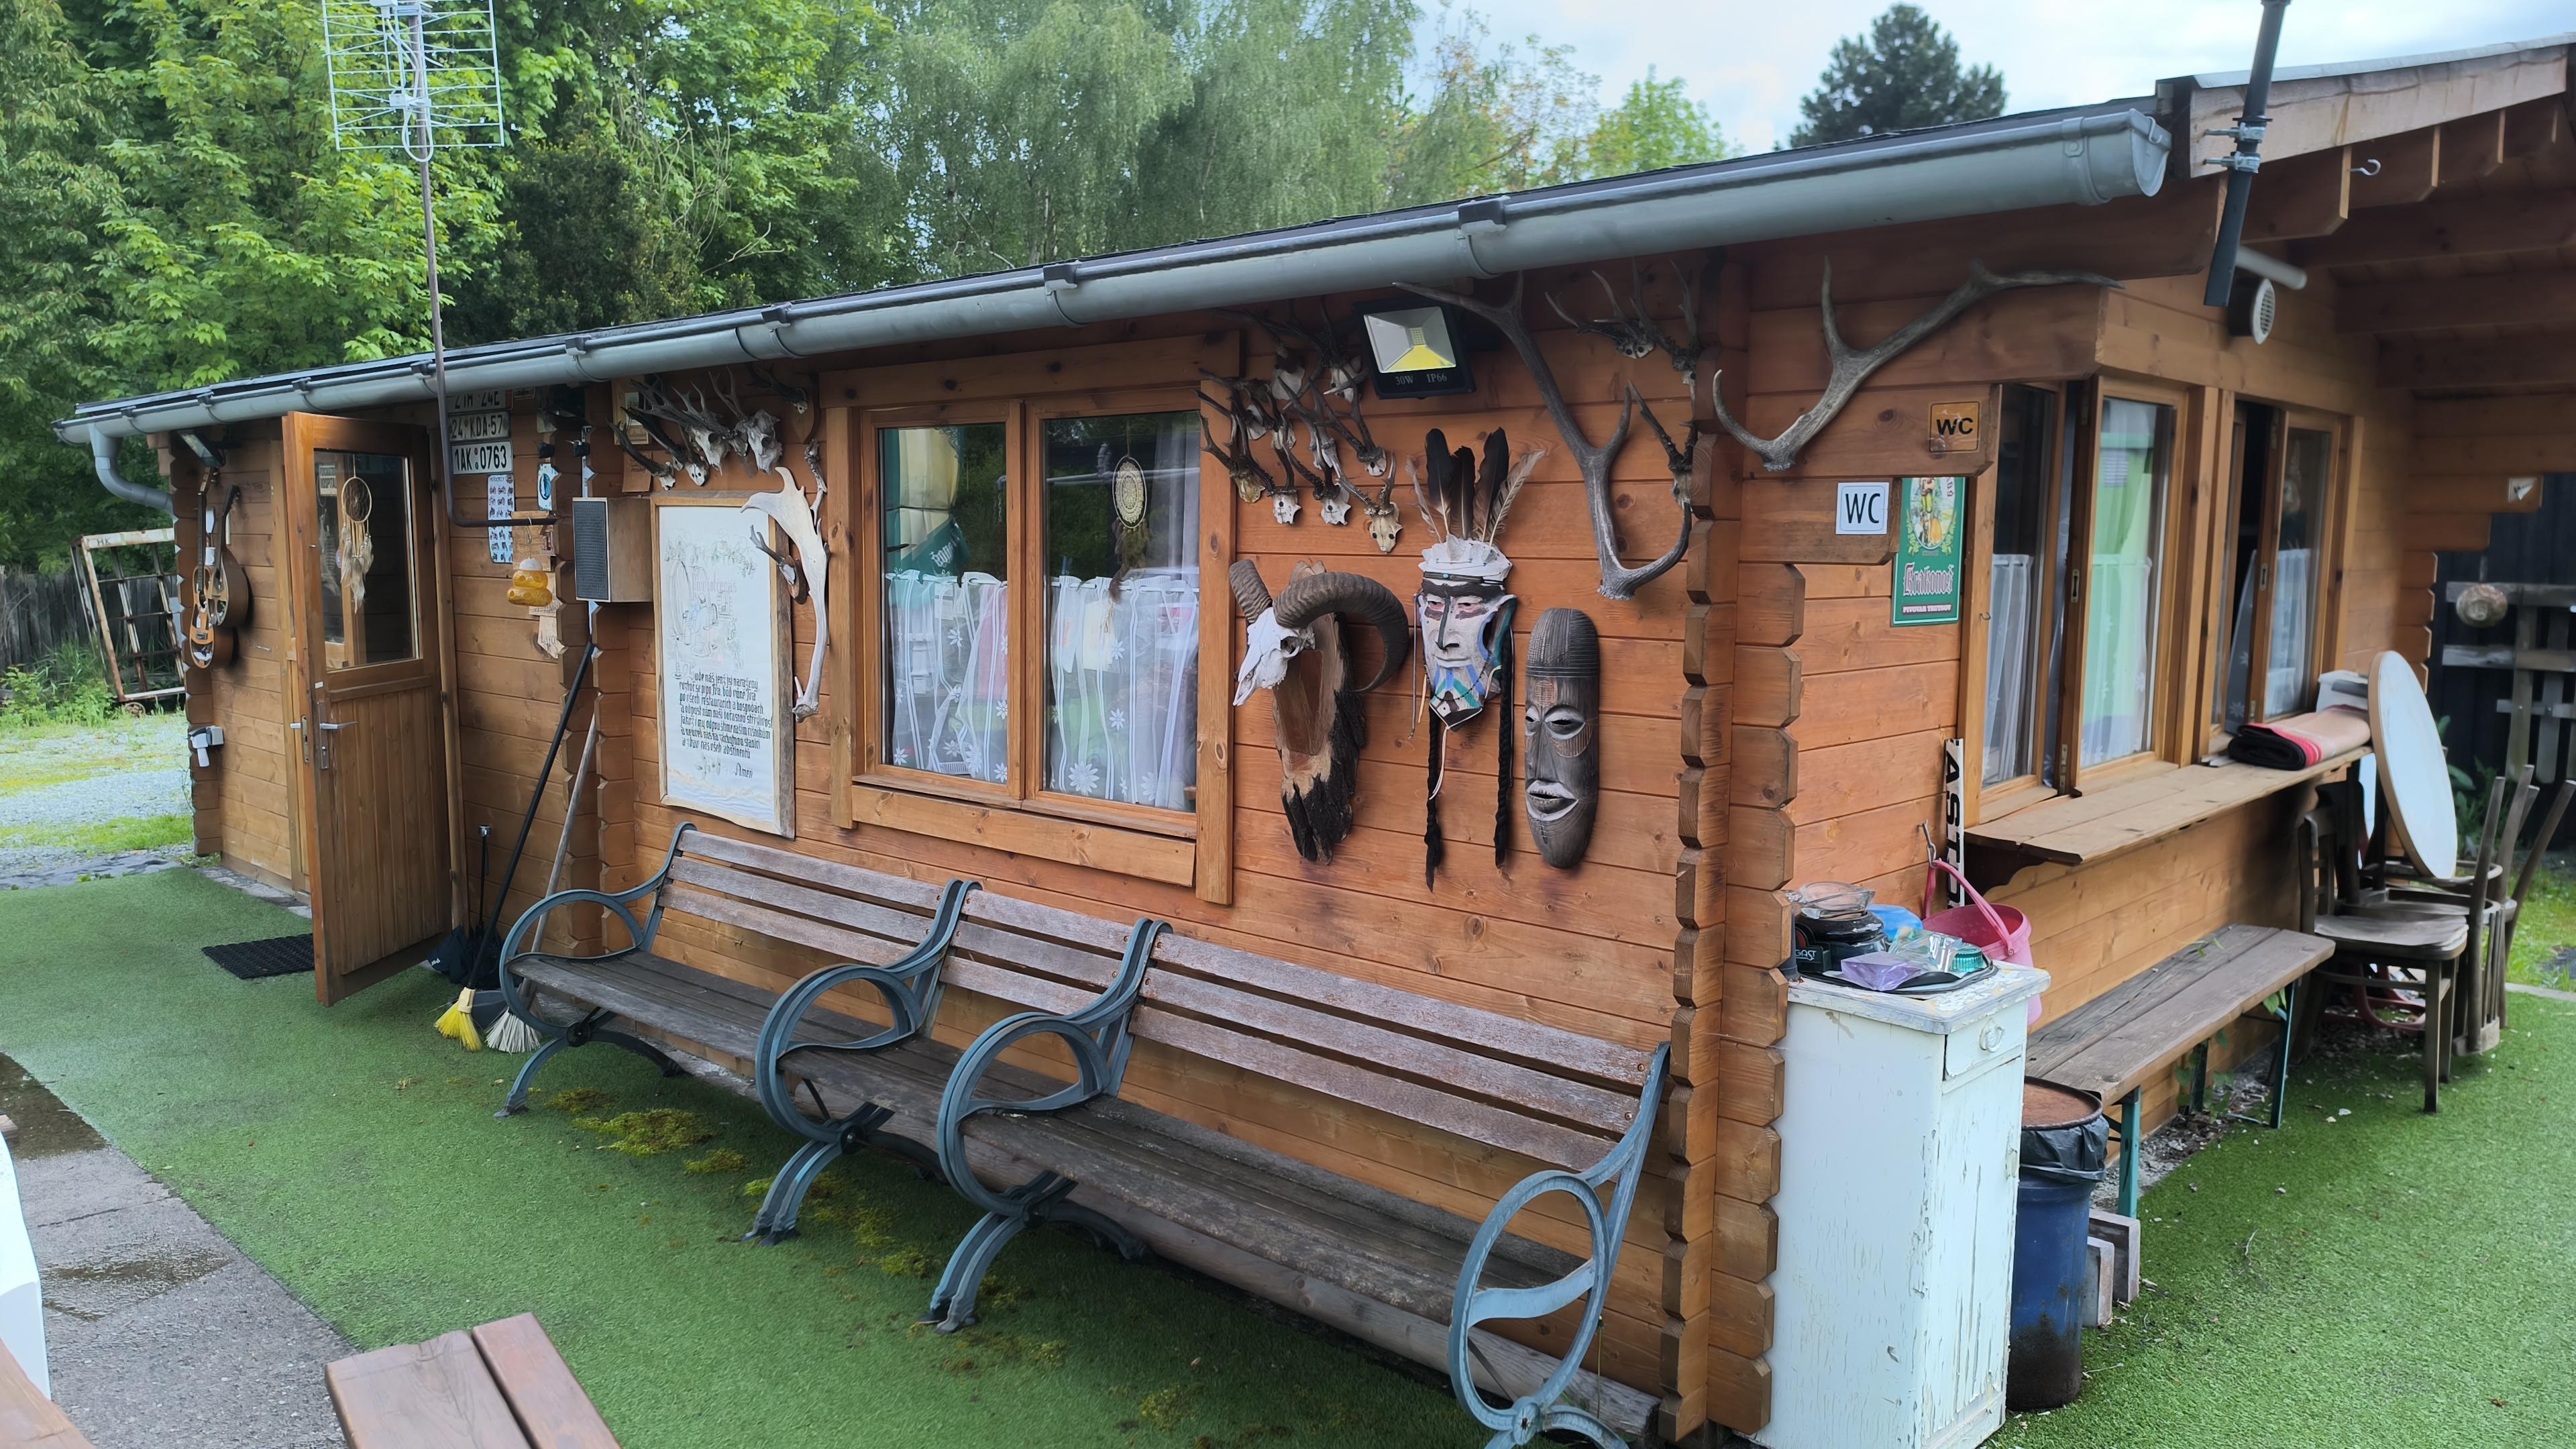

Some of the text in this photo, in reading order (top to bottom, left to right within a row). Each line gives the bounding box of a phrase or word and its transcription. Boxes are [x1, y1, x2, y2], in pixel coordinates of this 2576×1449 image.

[1395, 373, 1447, 385] 30W IP66
[1936, 417, 1974, 435] WC
[455, 445, 506, 471] 1AK 0763
[1845, 493, 1881, 524] WC
[1903, 562, 1955, 596] Krakonoš
